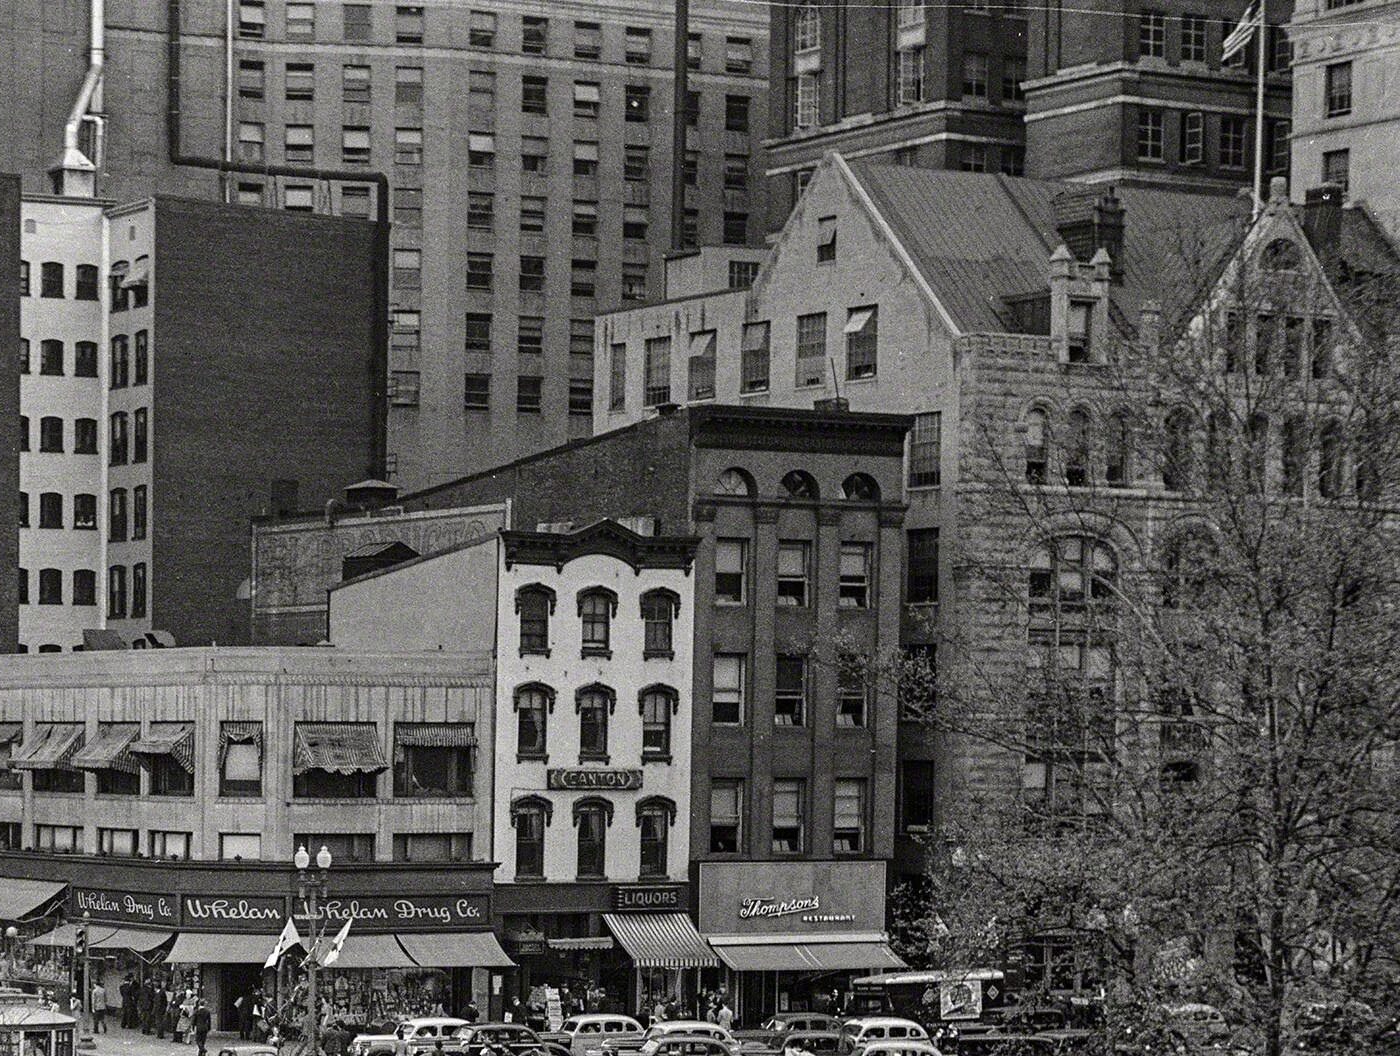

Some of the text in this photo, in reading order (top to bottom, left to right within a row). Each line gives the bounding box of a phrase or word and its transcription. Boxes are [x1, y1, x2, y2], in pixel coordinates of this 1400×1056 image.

[570, 772, 626, 786] CANTON
[77, 891, 120, 912] Whelan
[123, 894, 154, 920] Drug
[624, 892, 677, 904] LIQUORS
[187, 899, 281, 919] Whelan
[394, 900, 450, 922] Drug
[456, 899, 480, 918] Co.
